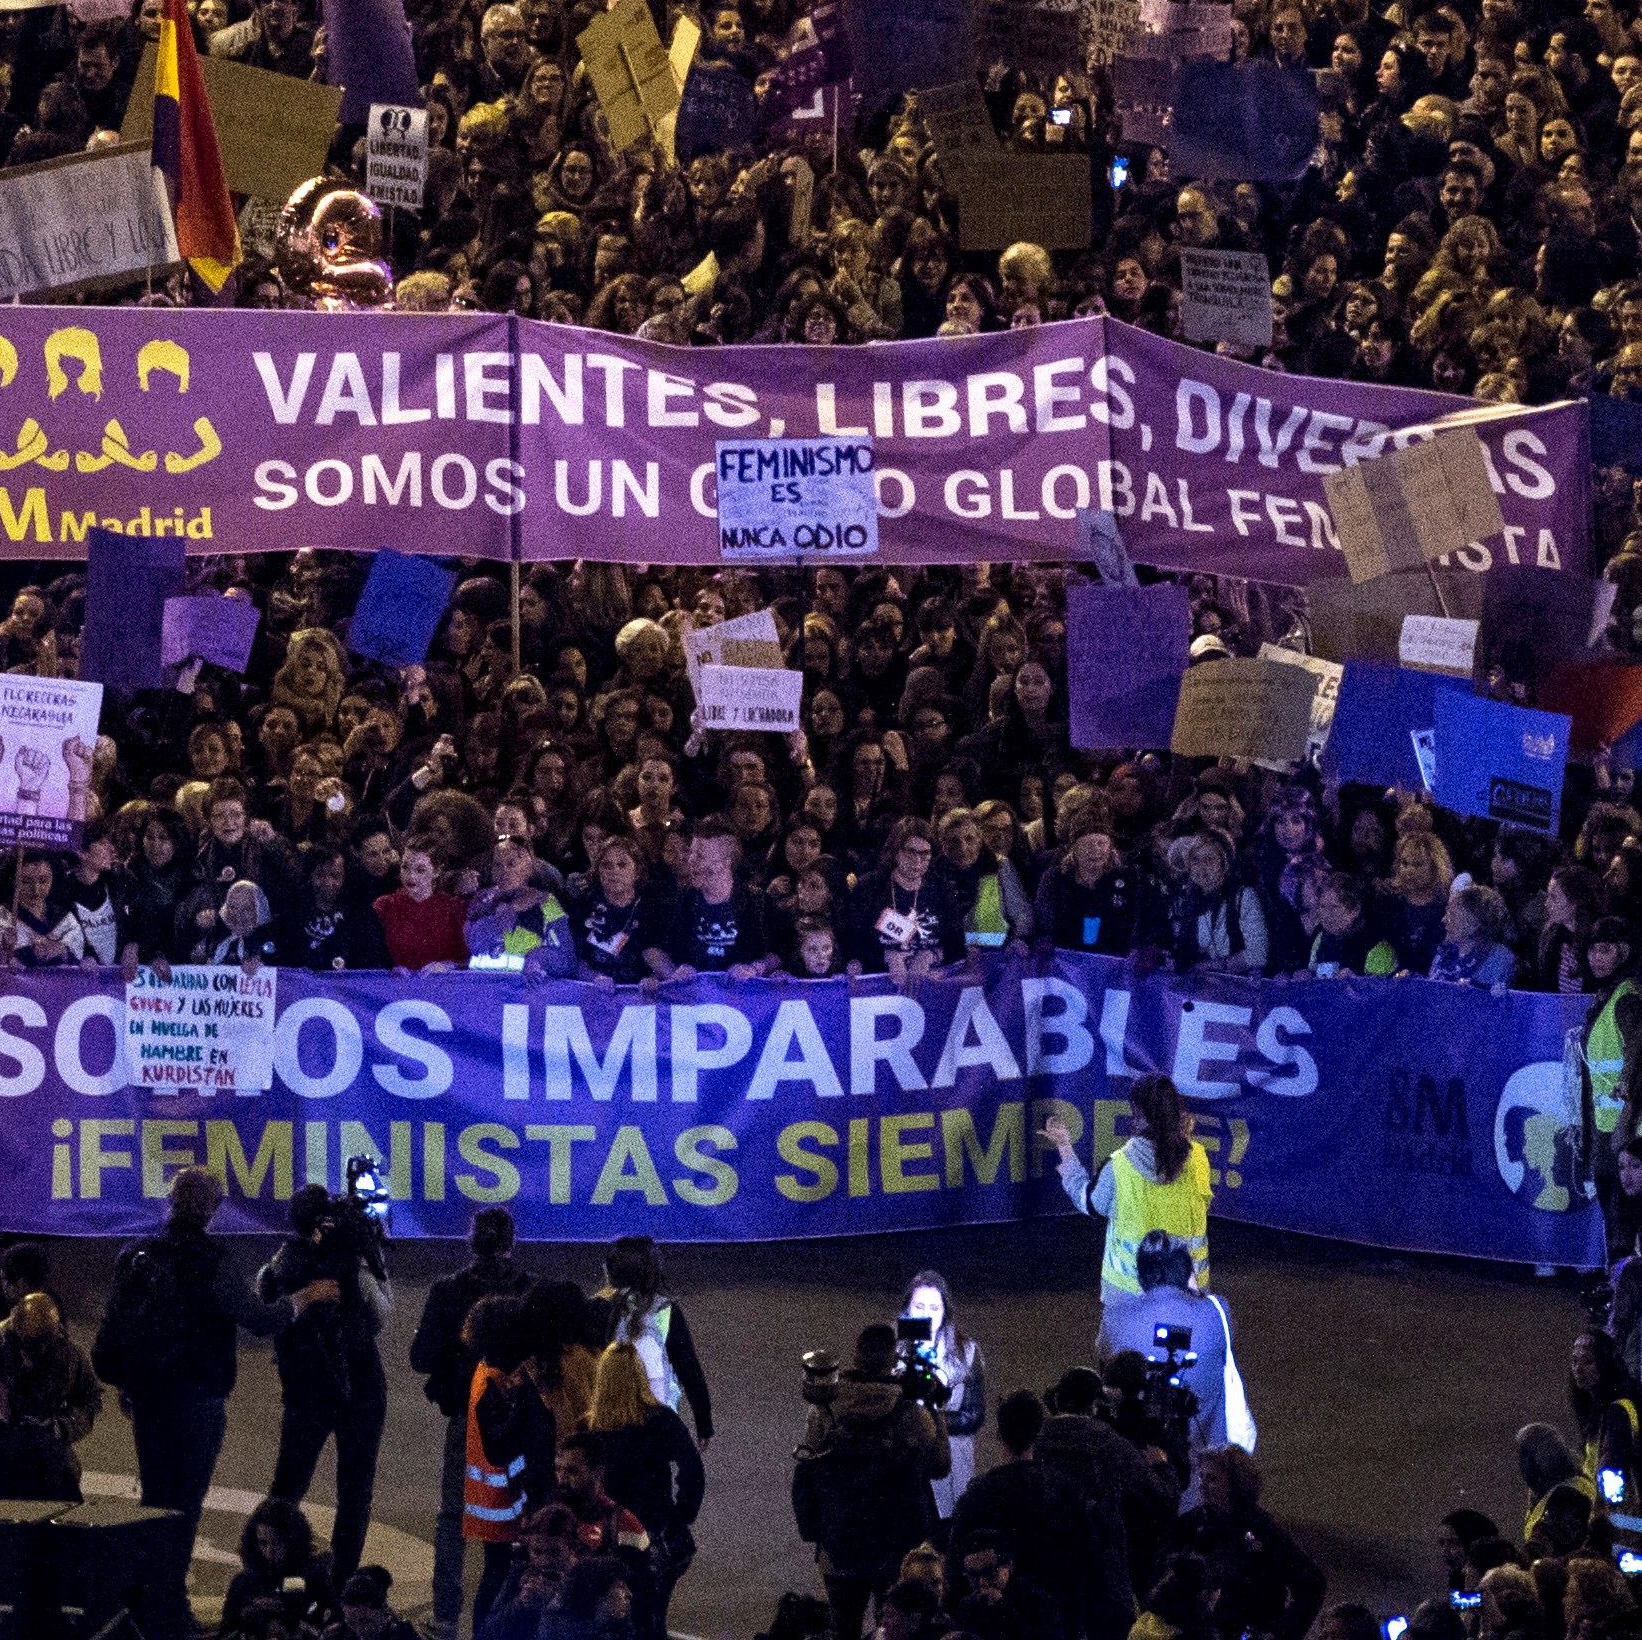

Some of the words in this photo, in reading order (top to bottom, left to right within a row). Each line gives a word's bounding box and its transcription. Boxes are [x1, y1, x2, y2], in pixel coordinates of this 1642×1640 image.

[371, 141, 420, 160] LIBERTAD,
[371, 163, 421, 182] IGUALDAD,
[253, 352, 785, 438] VALIENTES,
[813, 356, 1153, 450] LIBRES,
[720, 446, 876, 482] FEMINISMO
[253, 452, 527, 514] SOMOS
[555, 460, 659, 518] UN
[943, 462, 1214, 532] GLOBAL
[771, 482, 801, 503] ES
[61, 506, 214, 542] Madrid
[723, 526, 787, 549] NUNCA
[793, 523, 867, 549] ODIO
[18, 828, 68, 843] políticas
[26, 817, 52, 832] para
[54, 819, 73, 832] las
[212, 972, 239, 994] CON
[177, 997, 188, 1016] Y
[192, 997, 212, 1016] LAS
[215, 998, 264, 1020] MUJERES
[204, 1020, 220, 1039] DE
[502, 974, 1319, 1102] IMPARABLES
[209, 1046, 228, 1064] EN
[51, 1118, 738, 1206] ¡FEMINISTAS
